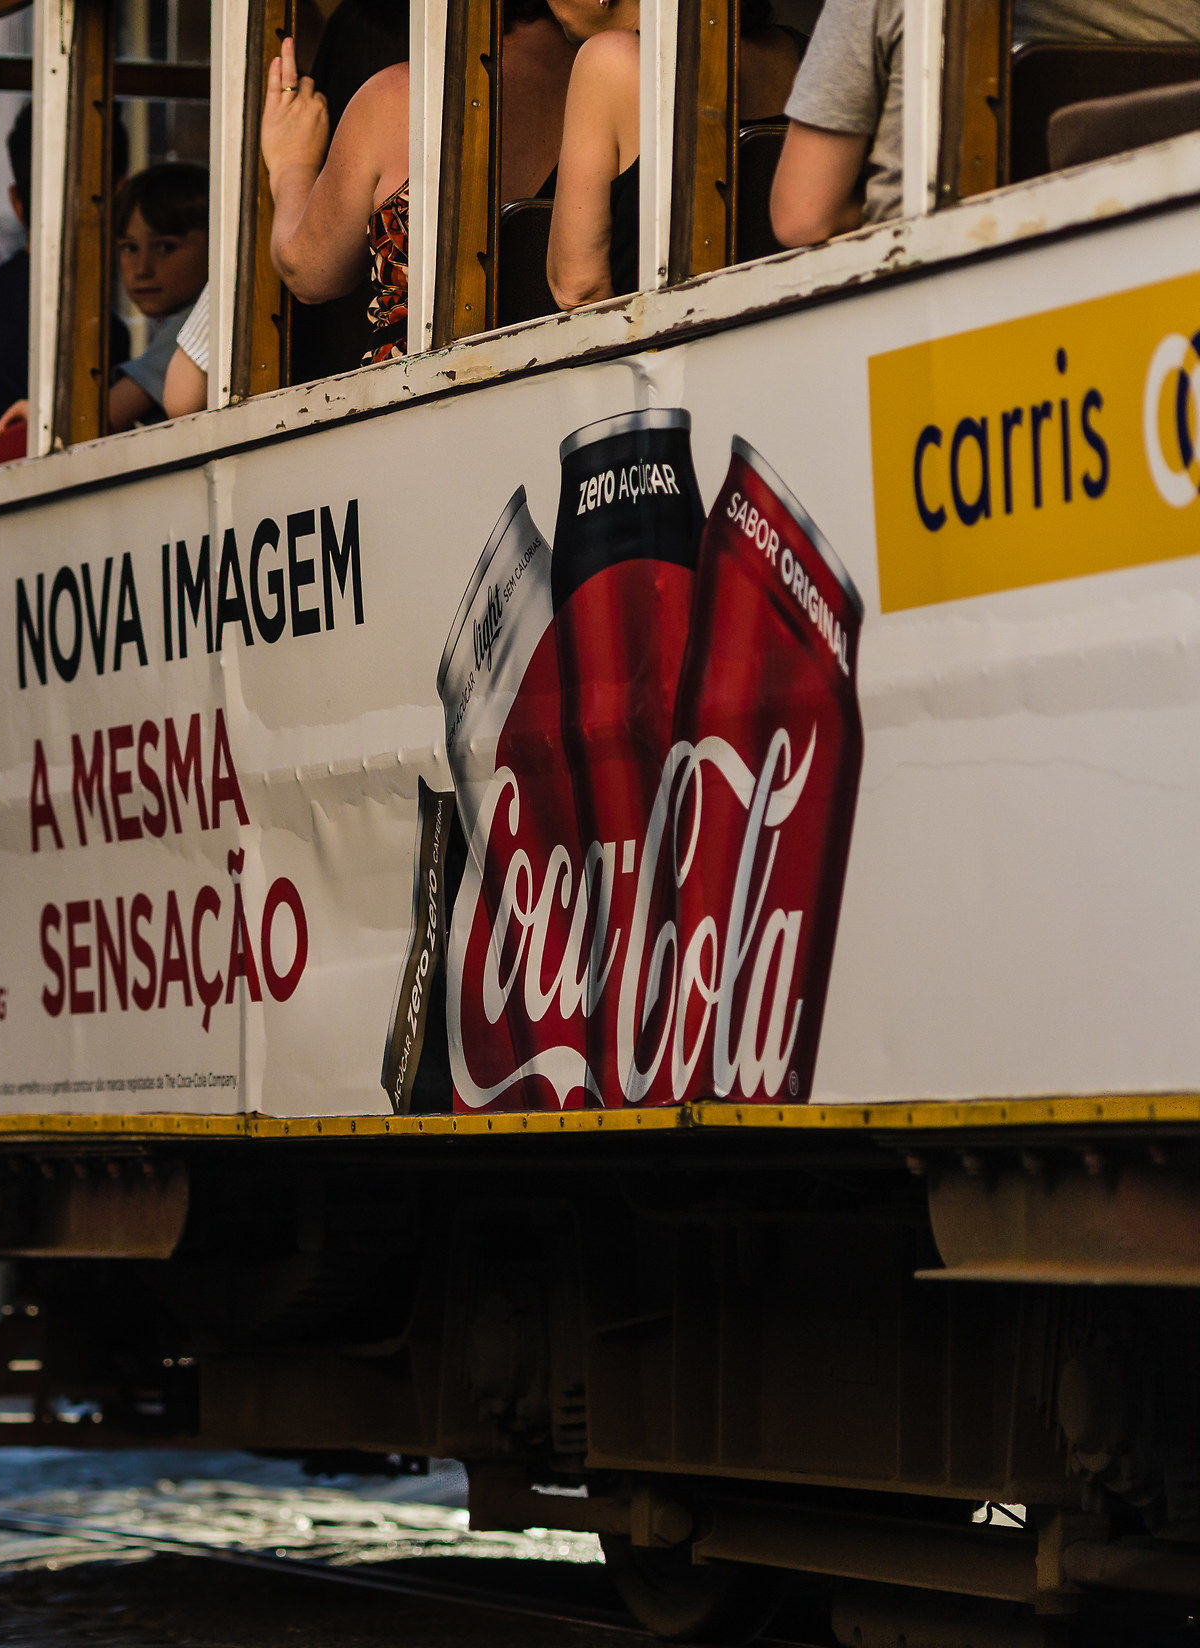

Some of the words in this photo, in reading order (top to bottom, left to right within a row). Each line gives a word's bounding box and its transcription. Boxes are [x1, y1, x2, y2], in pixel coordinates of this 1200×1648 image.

[577, 469, 615, 516] zero
[619, 458, 680, 504] AÇÚCAR
[913, 347, 1110, 533] carris
[16, 551, 148, 689] NOVA
[161, 498, 364, 662] IMAGEM
[473, 584, 503, 672] light
[503, 577, 516, 602] SEM
[514, 537, 542, 580] CALORIAS
[727, 492, 779, 566] SABOR
[780, 548, 850, 677] ORIGINAL
[31, 738, 65, 852] A
[71, 708, 250, 848] MESMA
[39, 847, 309, 1033] SENSAÇÃO
[407, 949, 429, 1039] zero
[427, 868, 438, 951] zero
[446, 721, 817, 1108] Coca-Cola
